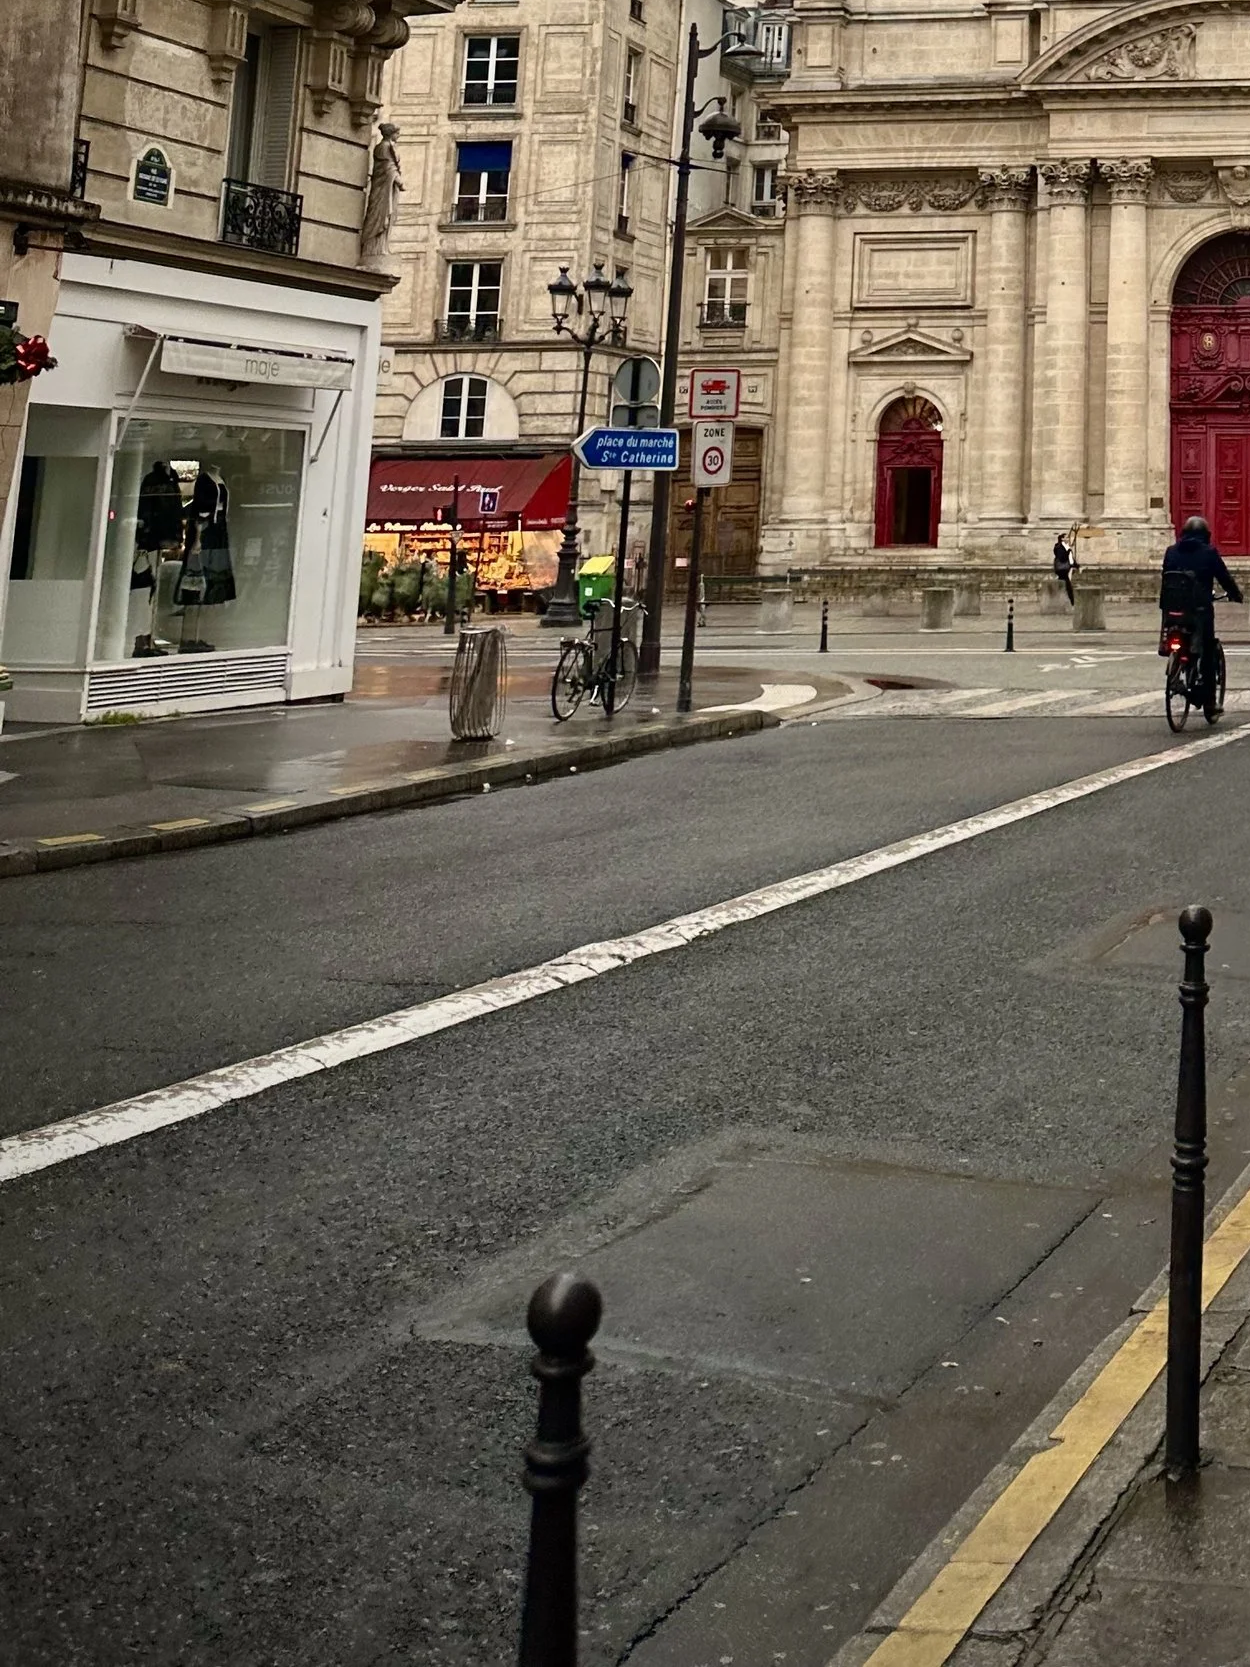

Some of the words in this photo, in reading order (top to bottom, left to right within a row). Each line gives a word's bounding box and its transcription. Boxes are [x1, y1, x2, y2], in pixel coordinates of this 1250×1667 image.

[245, 357, 280, 380] maje
[703, 428, 725, 437] ZONE
[596, 435, 624, 449] place
[626, 436, 638, 448] du
[640, 436, 675, 448] marché
[601, 450, 617, 463] Ste
[620, 451, 674, 464] Catherine
[707, 455, 719, 466] 30
[380, 484, 426, 493] Verger
[428, 483, 466, 493] Sait
